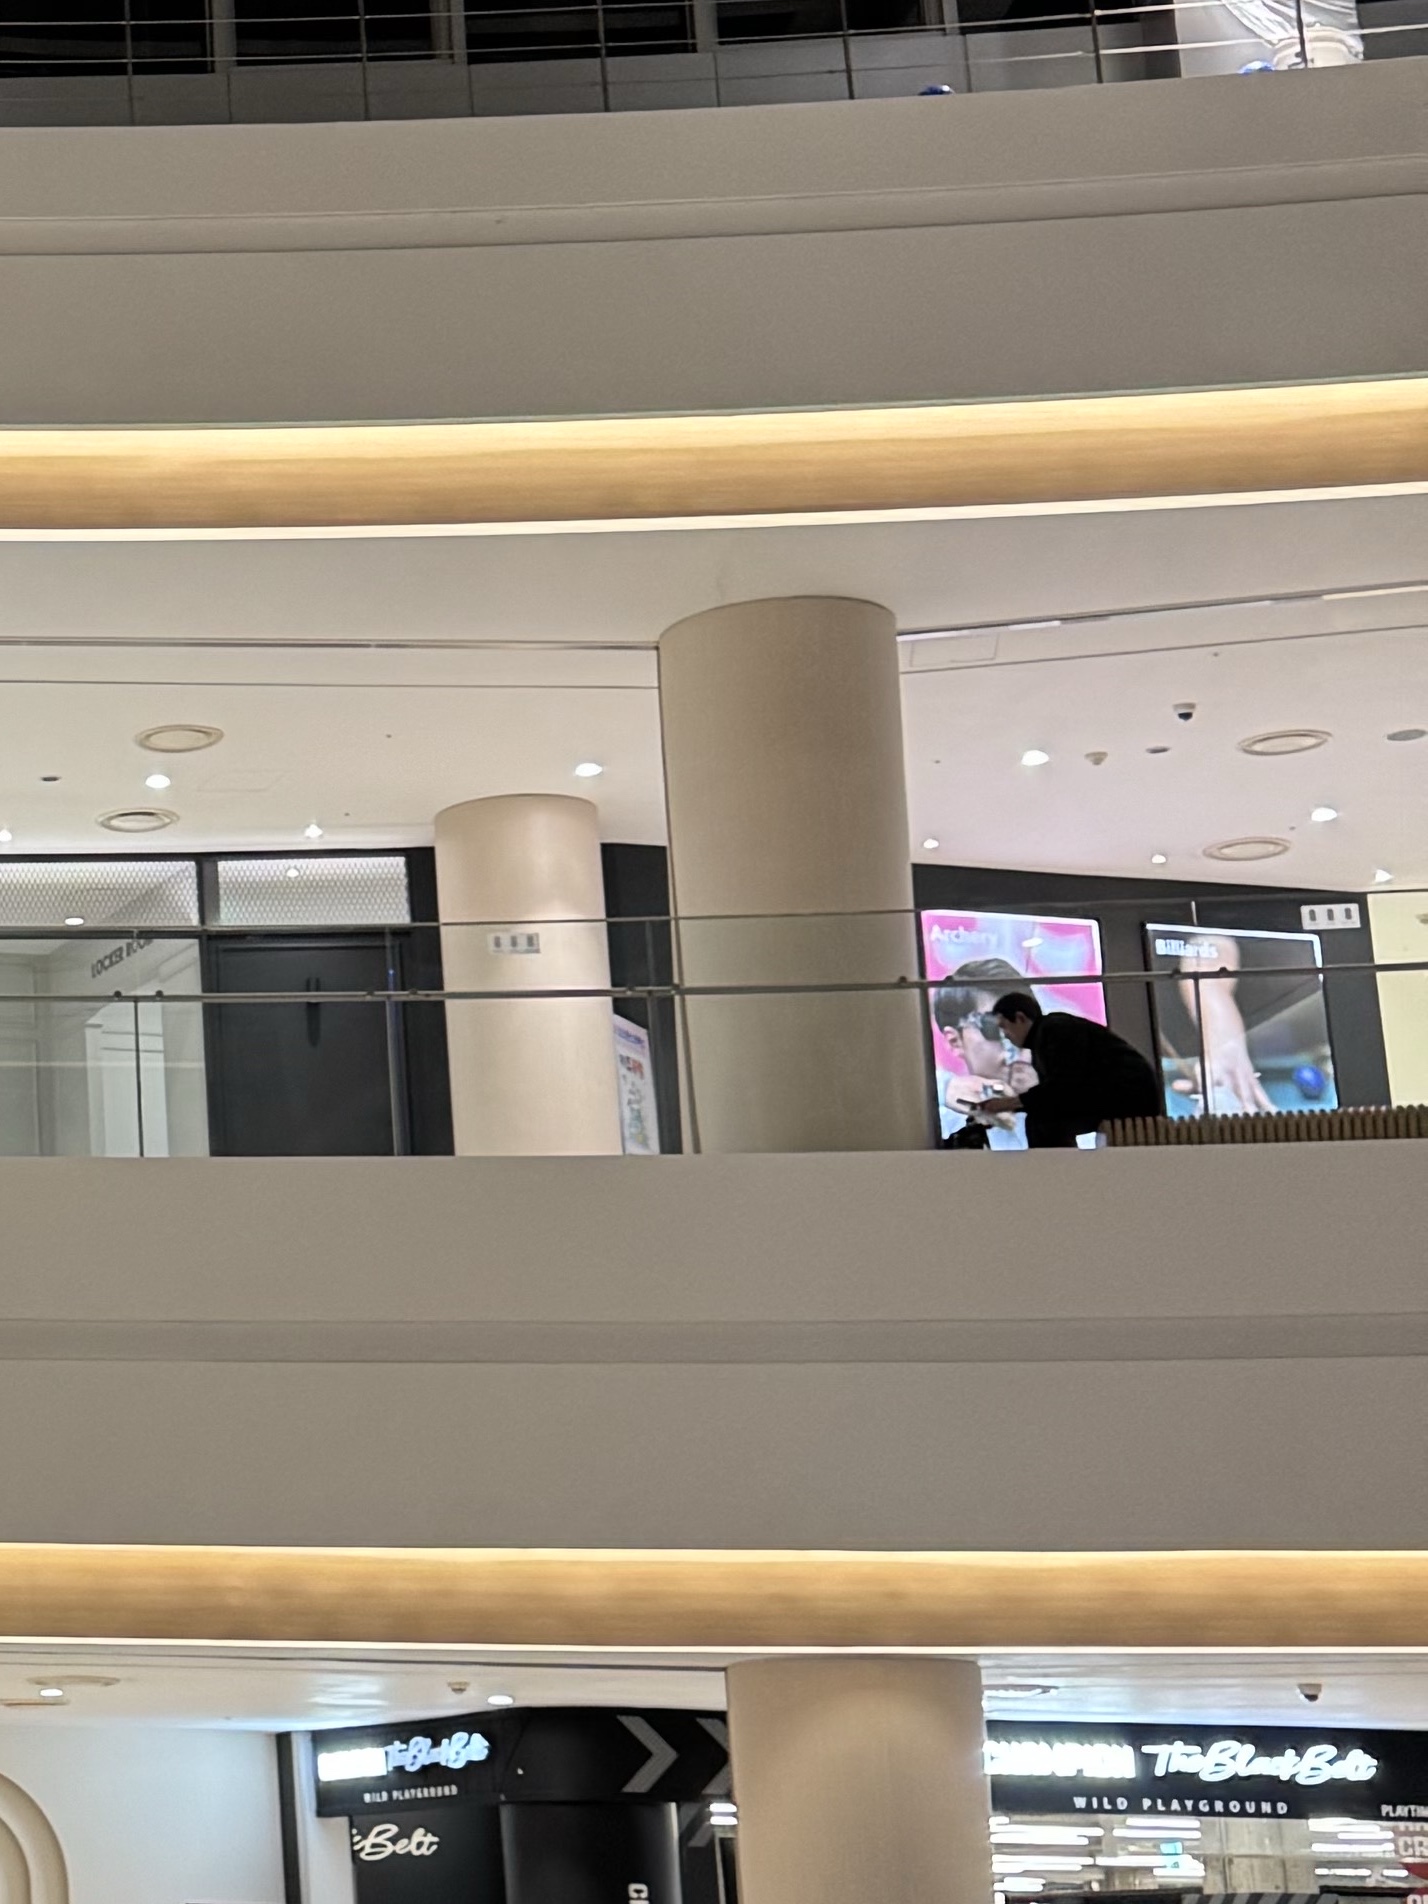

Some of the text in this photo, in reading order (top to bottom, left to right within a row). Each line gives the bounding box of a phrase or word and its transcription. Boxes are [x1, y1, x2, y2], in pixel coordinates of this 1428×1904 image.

[929, 923, 999, 948] Archery
[1155, 938, 1218, 959] Billiards
[1073, 1796, 1290, 1815] WILD PLAYGROUND
